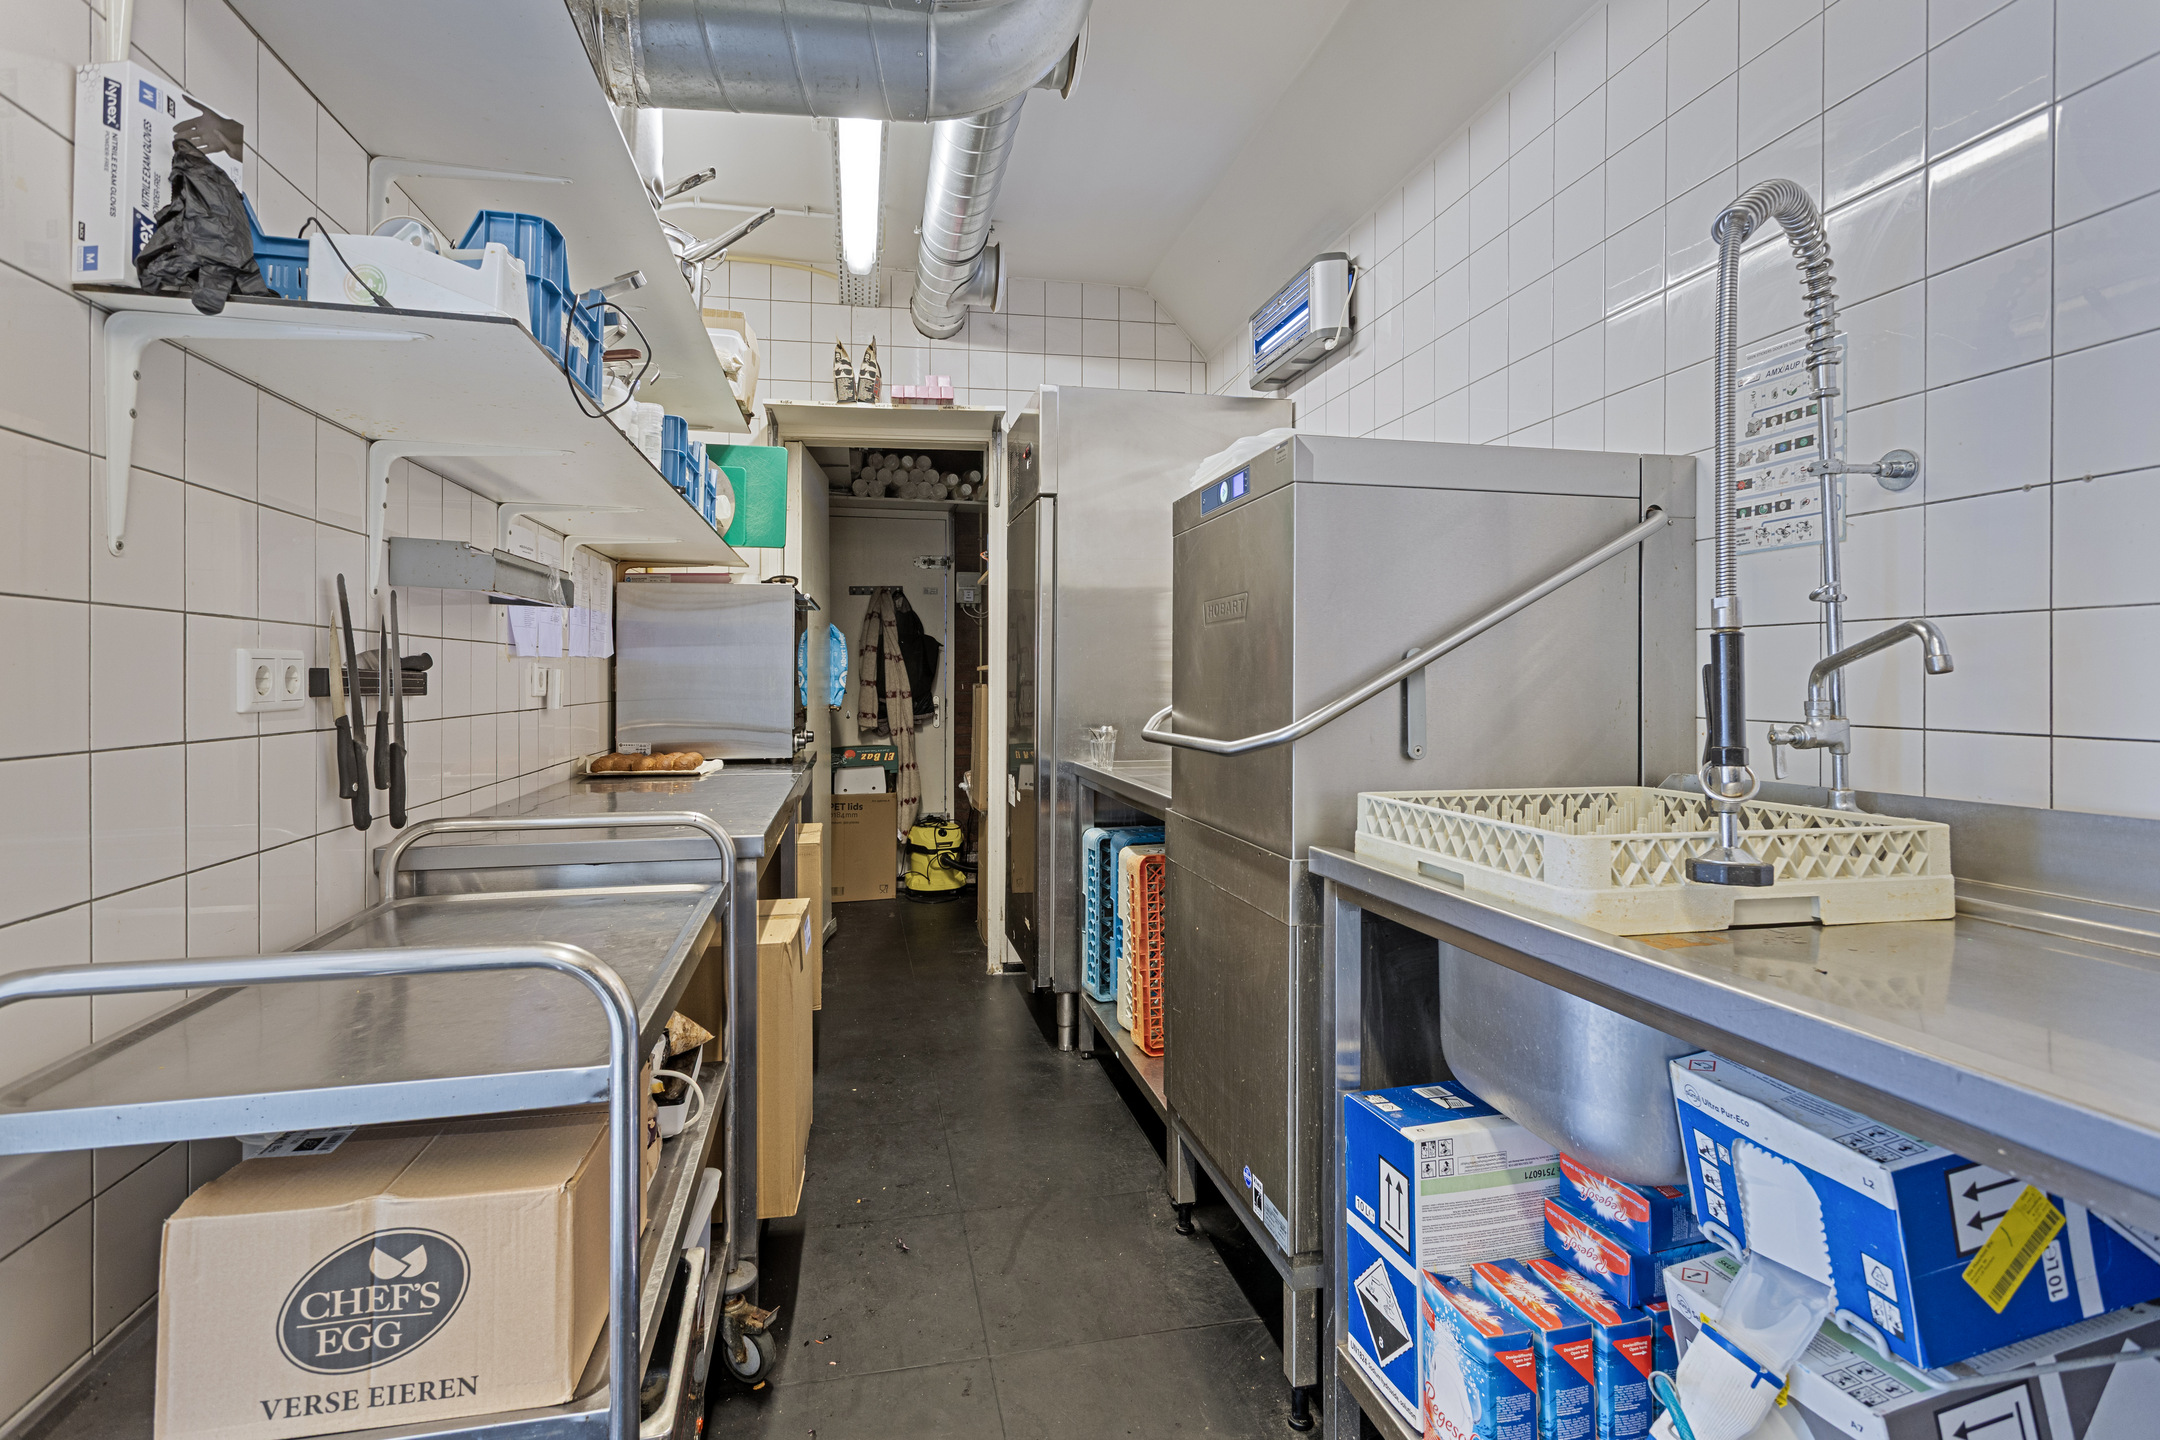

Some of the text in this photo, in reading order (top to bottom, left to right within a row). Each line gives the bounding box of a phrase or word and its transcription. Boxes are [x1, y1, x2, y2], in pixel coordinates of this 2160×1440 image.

[143, 88, 154, 102] M
[141, 119, 152, 210] NITRILE EXAM GLOVES
[86, 253, 95, 263] M
[1208, 600, 1244, 617] HOBART
[861, 752, 895, 761] El Baz
[848, 803, 863, 811] lids
[1702, 1096, 1720, 1112] Ultra
[1720, 1102, 1750, 1128] Pur-Eco
[1524, 1167, 1556, 1180] 7516071
[1862, 1176, 1875, 1190] L2
[1357, 1199, 1364, 1212] 10
[1578, 1186, 1628, 1222] Regesoft
[1561, 1234, 1608, 1274] Regesoft
[2046, 1260, 2063, 1298] 10 L
[300, 1281, 440, 1320] CHEF'S
[315, 1321, 402, 1357] EGG
[1379, 1336, 1384, 1348] 8
[260, 1375, 480, 1421] VERSE EIEREN
[1425, 1381, 1480, 1440] Regeso
